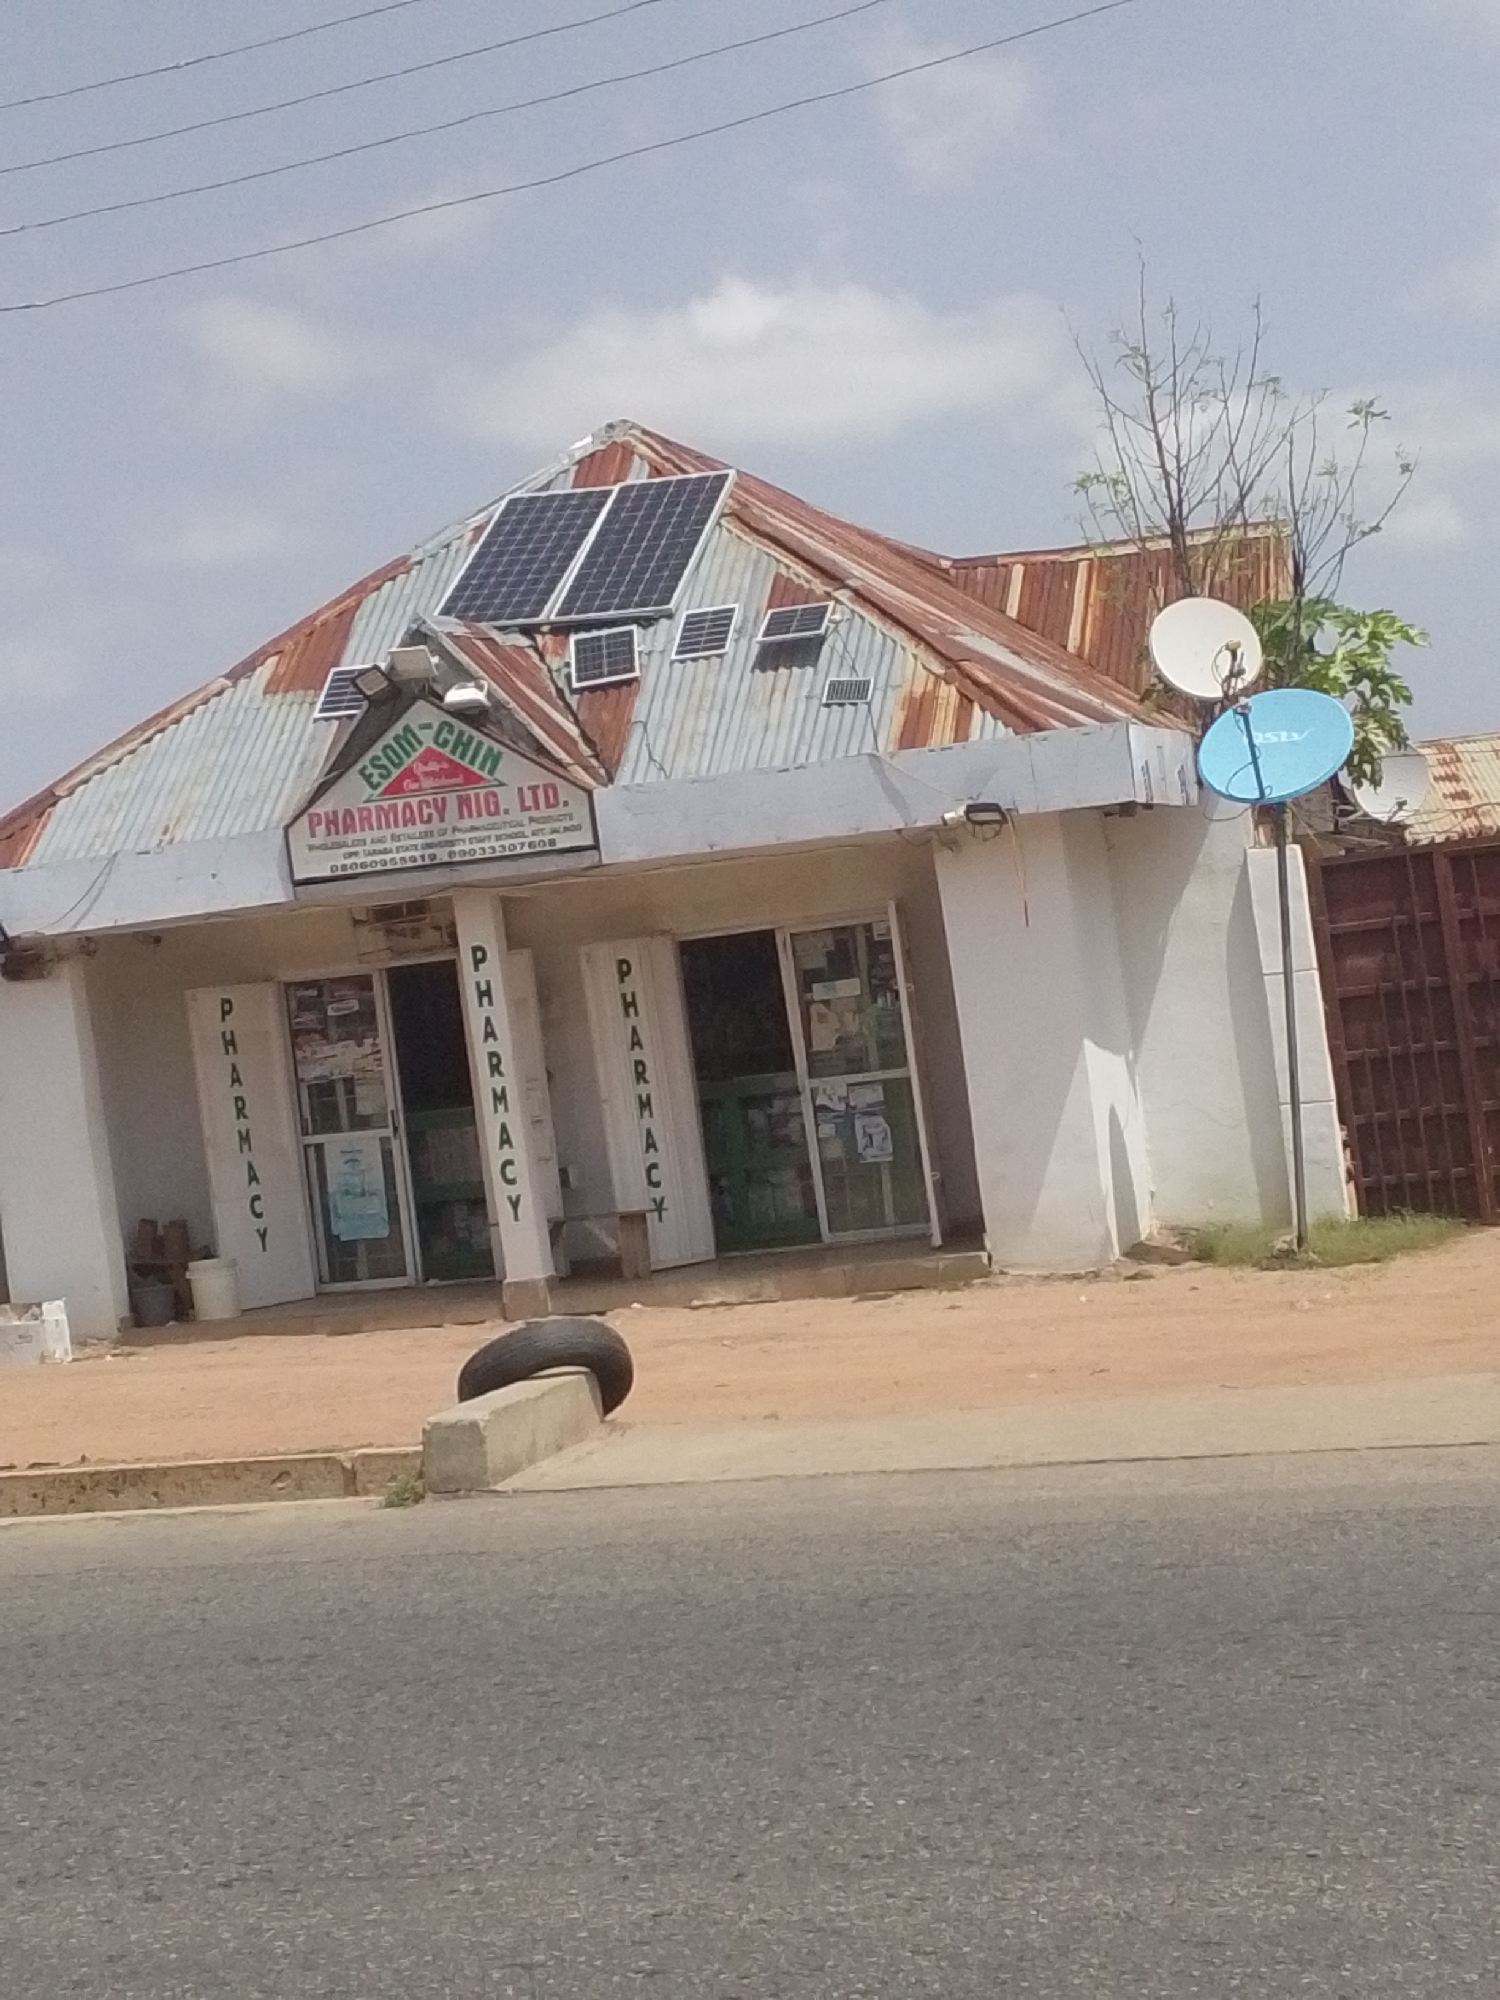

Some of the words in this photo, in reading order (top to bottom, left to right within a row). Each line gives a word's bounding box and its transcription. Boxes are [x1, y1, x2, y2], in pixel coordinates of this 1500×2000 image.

[308, 795, 448, 838] PHARMACY
[457, 791, 509, 820] NIG.
[517, 782, 569, 812] LTD.
[357, 720, 503, 791] ESOM-CHIN
[219, 997, 268, 1253] PHARMACY
[471, 945, 521, 1223] PHARMACY
[616, 957, 667, 1223] PHARMACY
